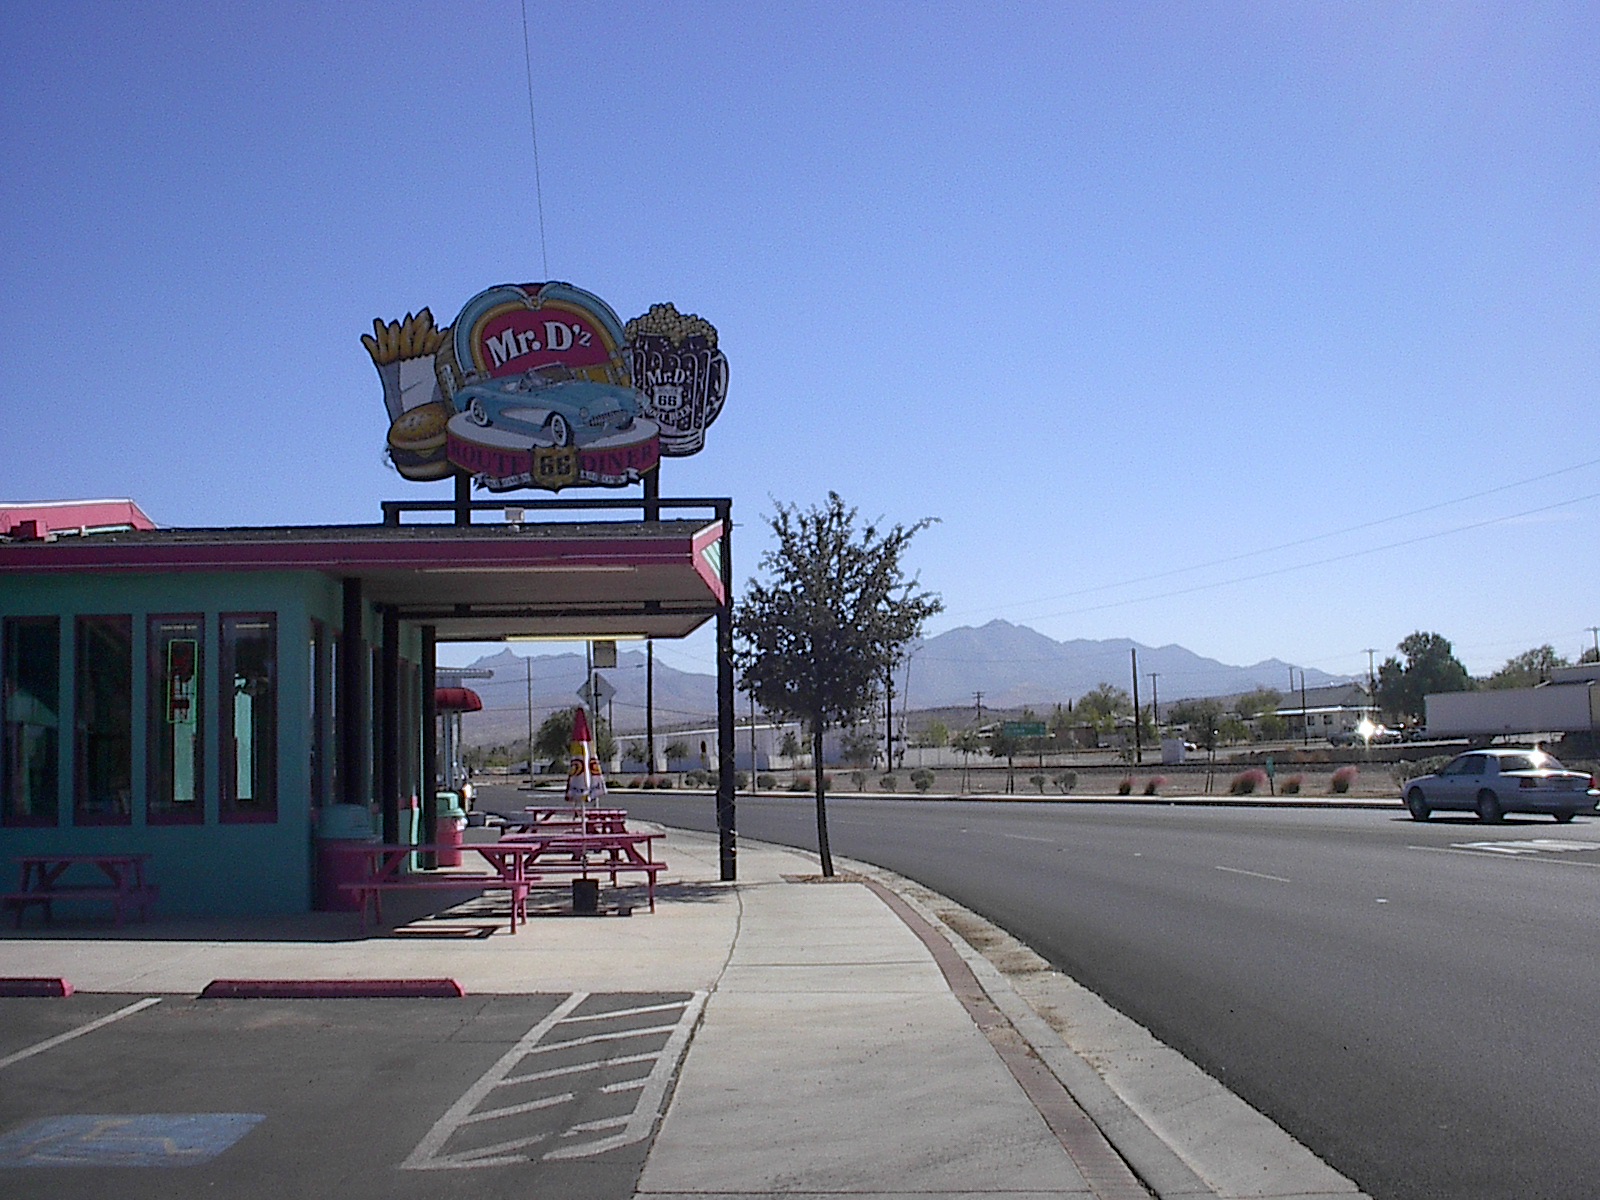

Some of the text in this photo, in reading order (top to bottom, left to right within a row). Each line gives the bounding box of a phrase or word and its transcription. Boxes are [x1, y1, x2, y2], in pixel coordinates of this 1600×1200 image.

[485, 319, 593, 368] Mr. D'z
[646, 368, 673, 387] Mr.
[657, 395, 678, 407] 66
[451, 441, 653, 476] ROUTE 66 DINER
